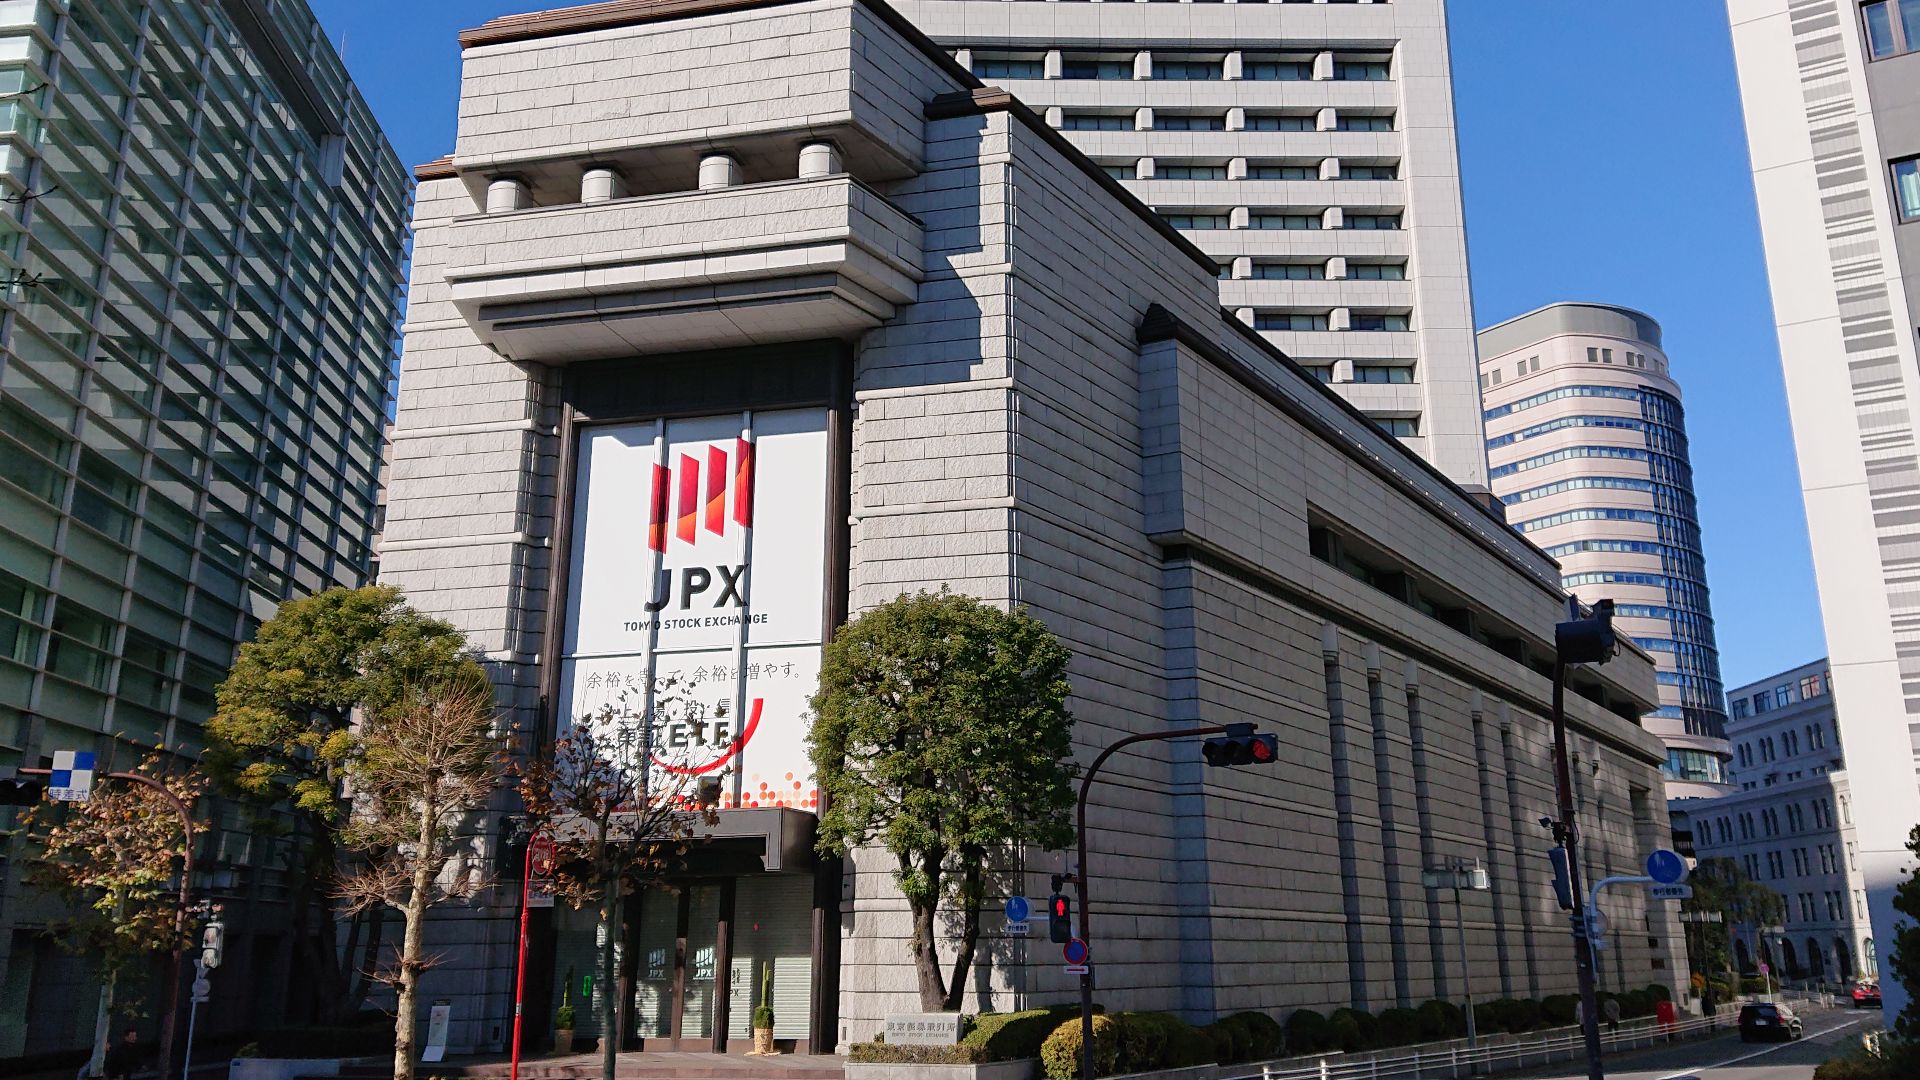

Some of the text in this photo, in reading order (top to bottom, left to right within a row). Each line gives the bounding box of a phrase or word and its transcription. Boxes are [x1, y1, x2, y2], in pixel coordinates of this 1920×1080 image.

[643, 563, 749, 612] JPX
[624, 613, 768, 632] TOKYO STOCK EXCHANGE
[49, 788, 88, 800] 時差式
[648, 969, 665, 978] JPX
[695, 968, 713, 978] JPX
